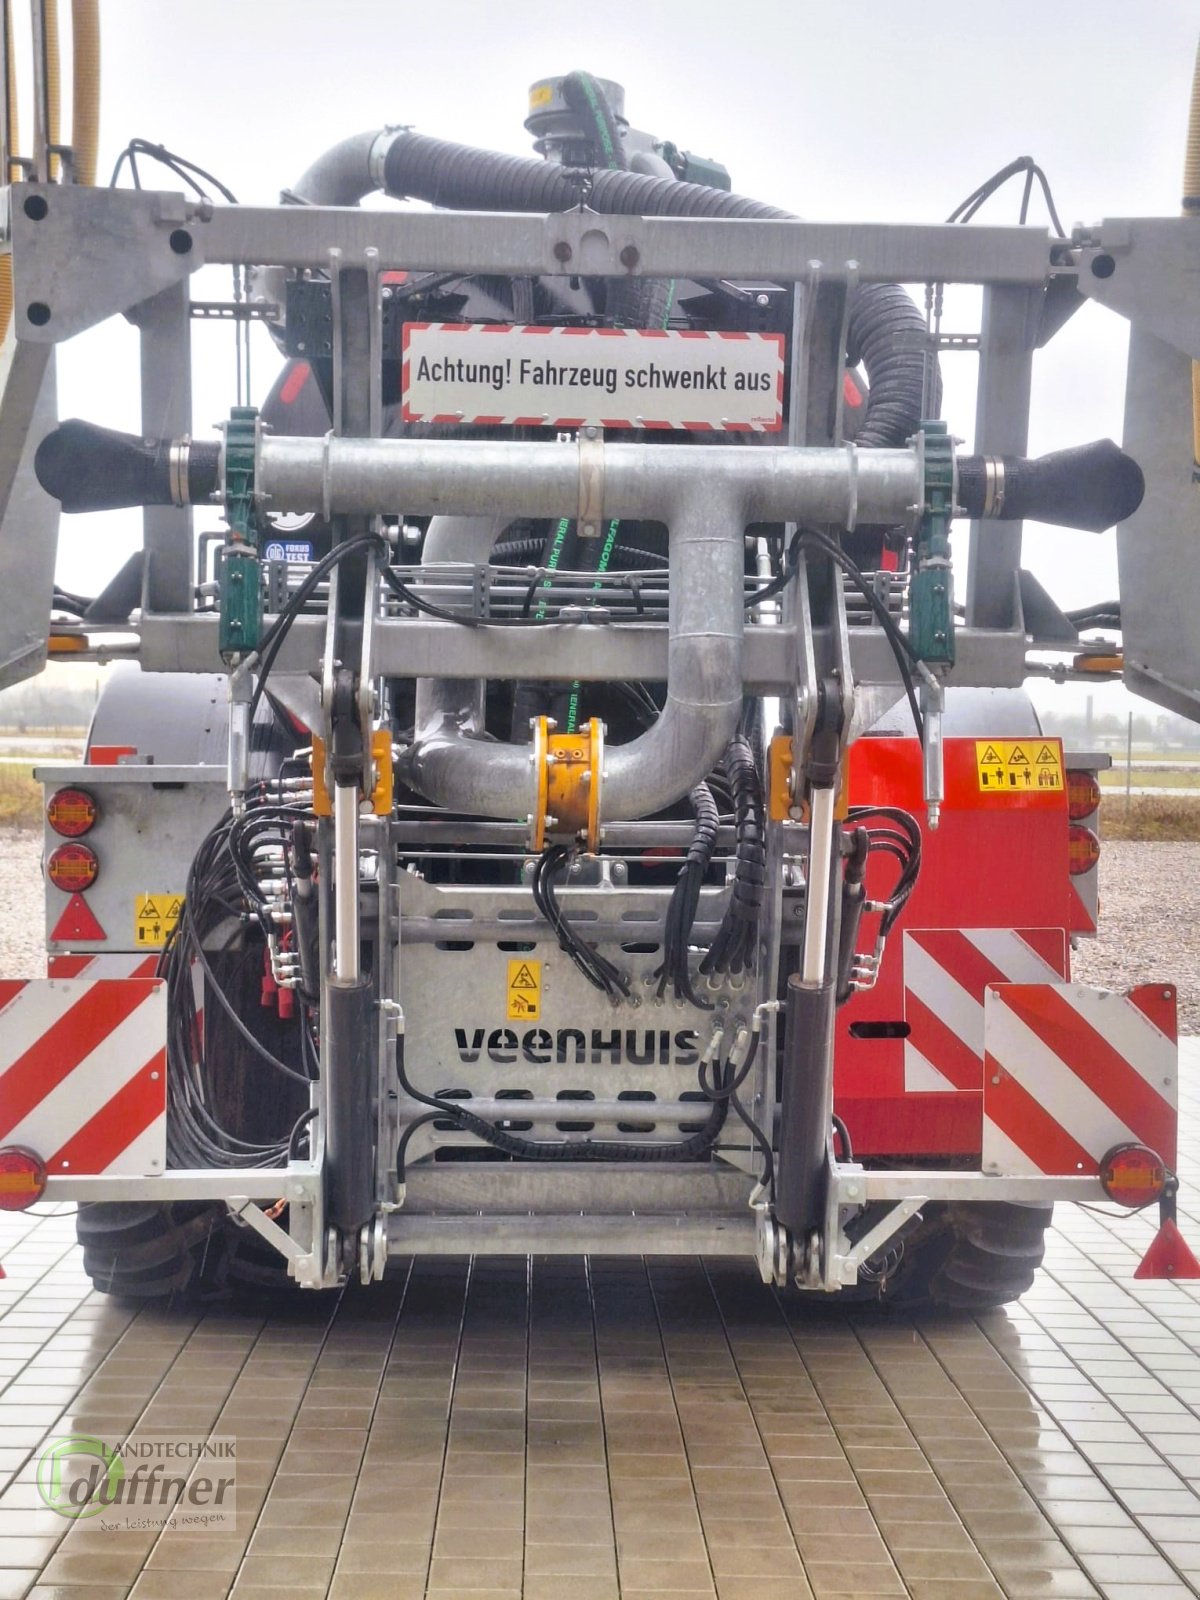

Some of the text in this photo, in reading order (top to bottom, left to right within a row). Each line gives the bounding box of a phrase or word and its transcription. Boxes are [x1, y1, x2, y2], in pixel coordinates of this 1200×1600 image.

[416, 355, 771, 393] Achtung! Fahrzeug schwenkt aus
[286, 553, 309, 562] TEST
